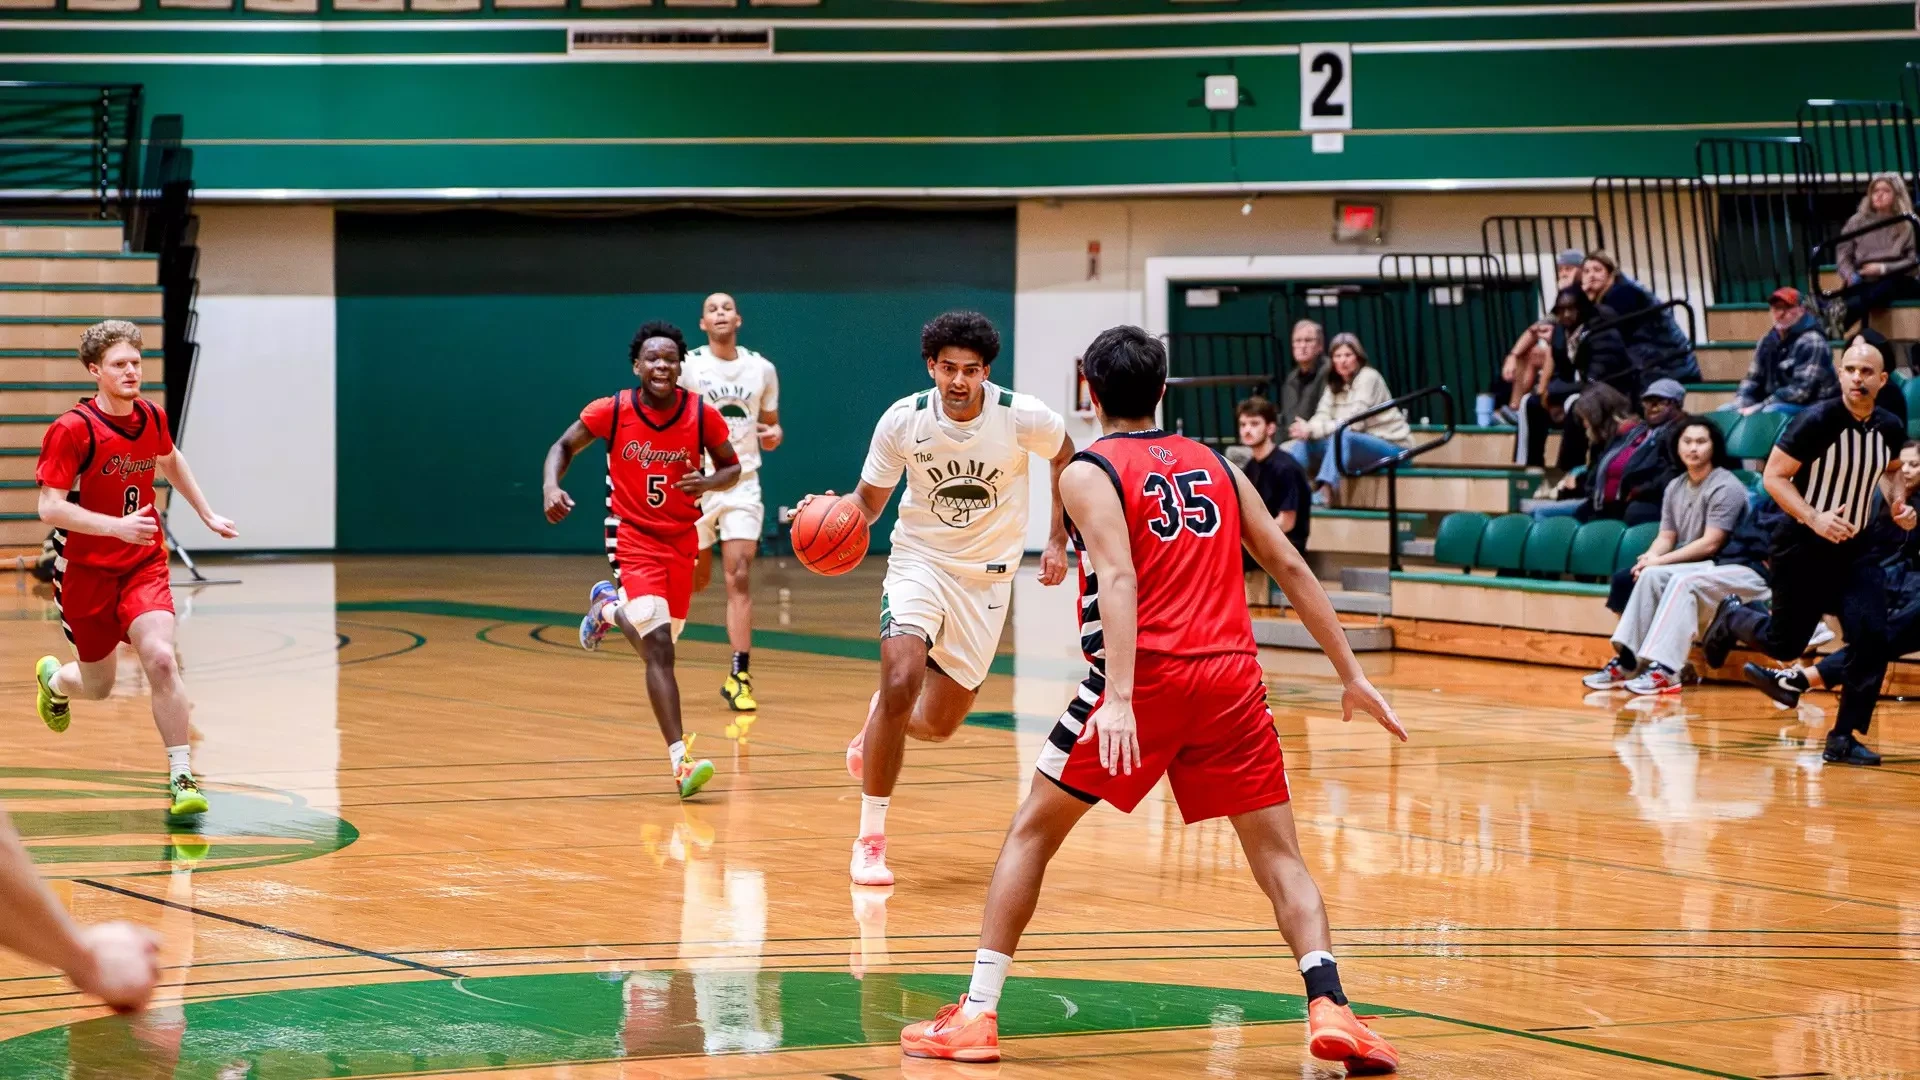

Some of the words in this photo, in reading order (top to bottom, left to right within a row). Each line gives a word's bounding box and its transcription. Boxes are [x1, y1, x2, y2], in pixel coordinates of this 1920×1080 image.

[1311, 52, 1344, 117] 2
[913, 451, 935, 463] The
[926, 459, 1004, 484] DOME
[123, 485, 140, 517] 8
[646, 474, 667, 508] 5
[1142, 468, 1221, 542] 35
[952, 508, 970, 522] 21
